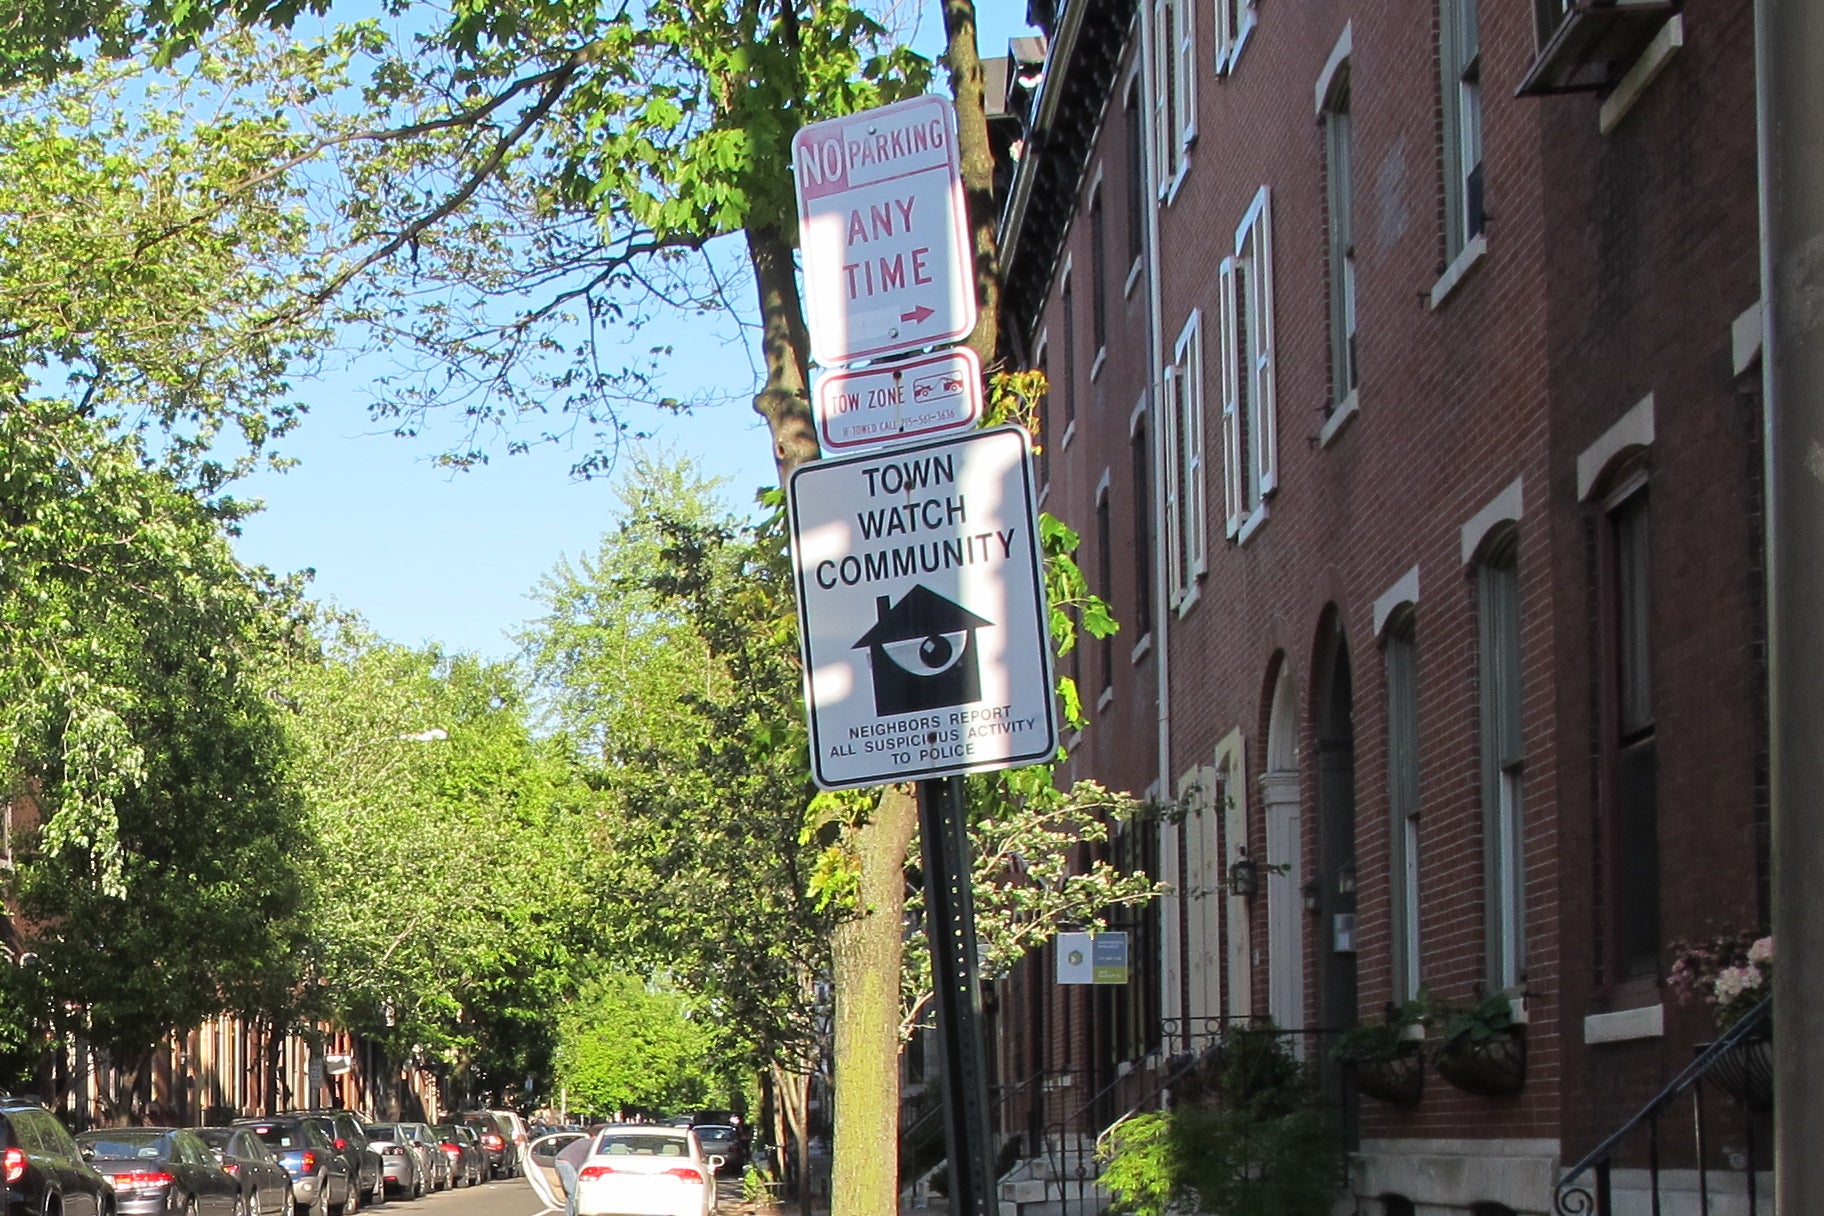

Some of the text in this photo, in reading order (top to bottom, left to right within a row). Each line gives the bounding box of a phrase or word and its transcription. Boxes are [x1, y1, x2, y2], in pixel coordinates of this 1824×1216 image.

[799, 119, 944, 189] NO PARKING
[847, 195, 916, 247] ANY
[842, 247, 933, 299] TIME
[832, 385, 905, 414] TOW ZONE
[842, 426, 849, 437] IF
[850, 423, 877, 436] TOWED
[879, 420, 897, 432] CALL
[862, 454, 954, 498] TOWN
[857, 494, 967, 542] WATCH
[815, 528, 1016, 591] COMMUNITY
[830, 717, 1035, 758] ALL SUSPICIUS ACTIVITY
[849, 705, 1011, 739] NEIGHBORS REPORT
[891, 743, 974, 765] TO POLICE
